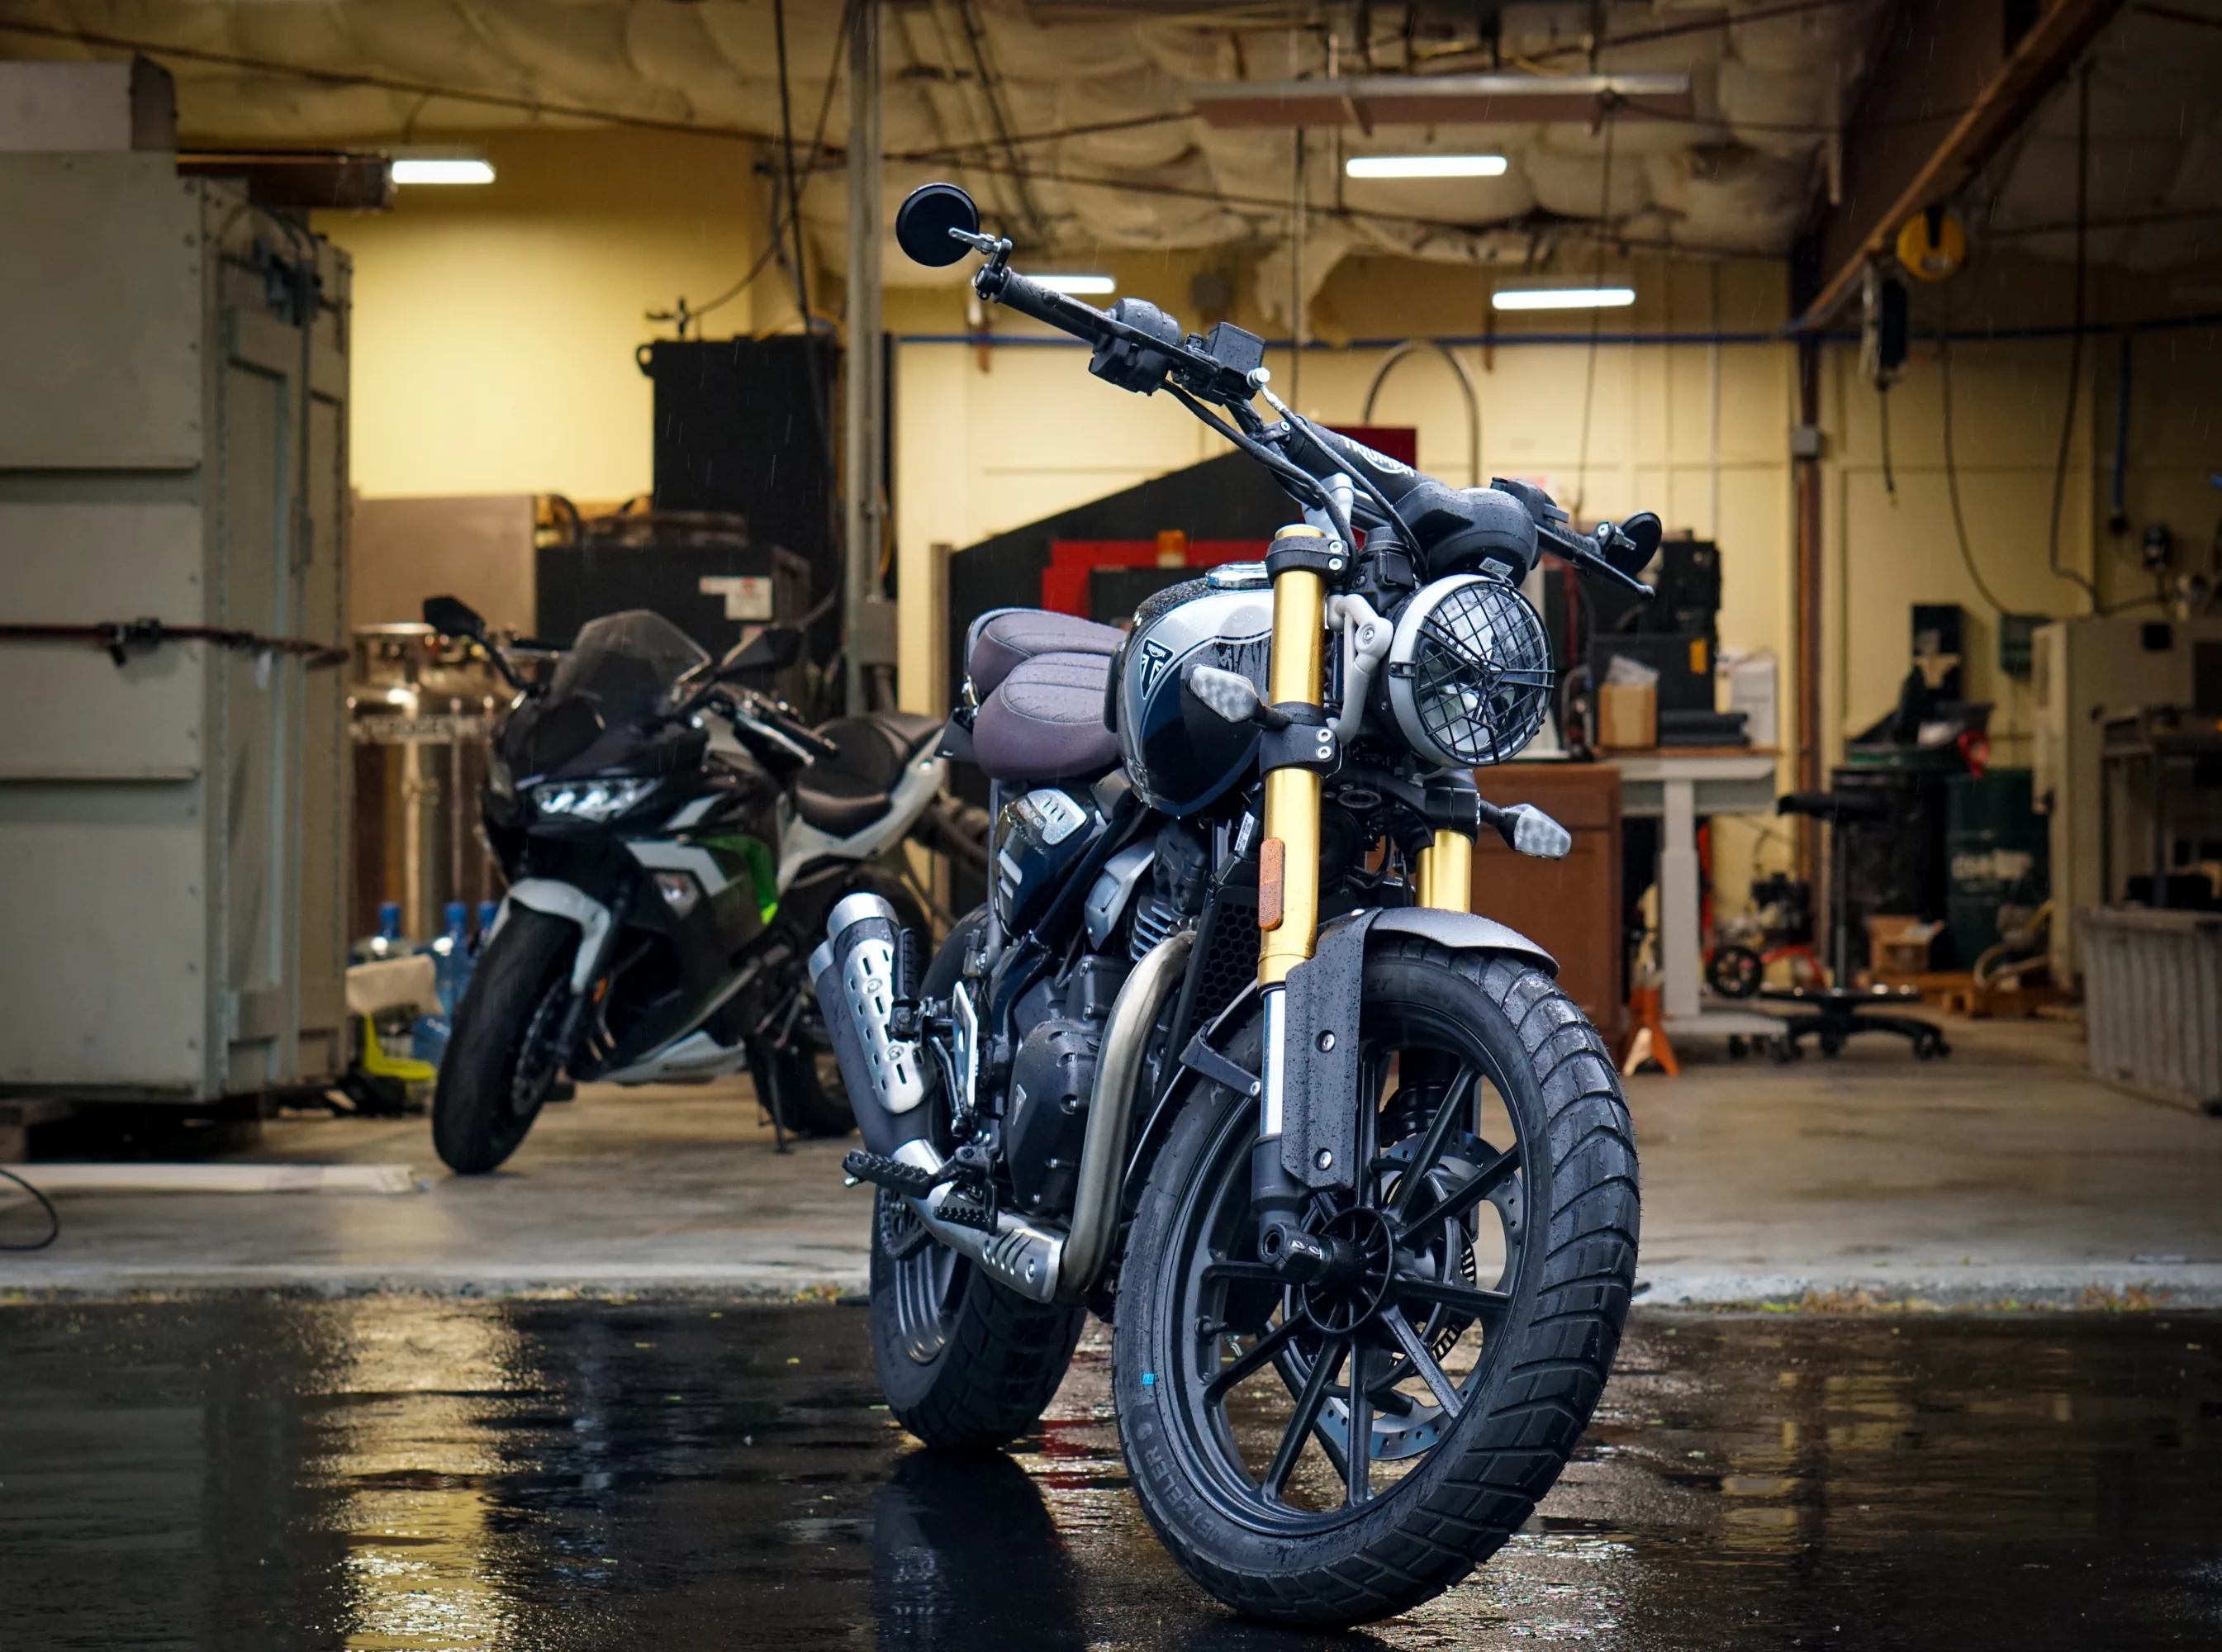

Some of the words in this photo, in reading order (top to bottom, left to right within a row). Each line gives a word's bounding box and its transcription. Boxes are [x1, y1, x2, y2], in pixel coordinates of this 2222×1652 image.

[1339, 434, 1415, 477] TRIUMPH
[1147, 643, 1166, 657] TRIUMPH
[1145, 1445, 1233, 1550] METZELER
